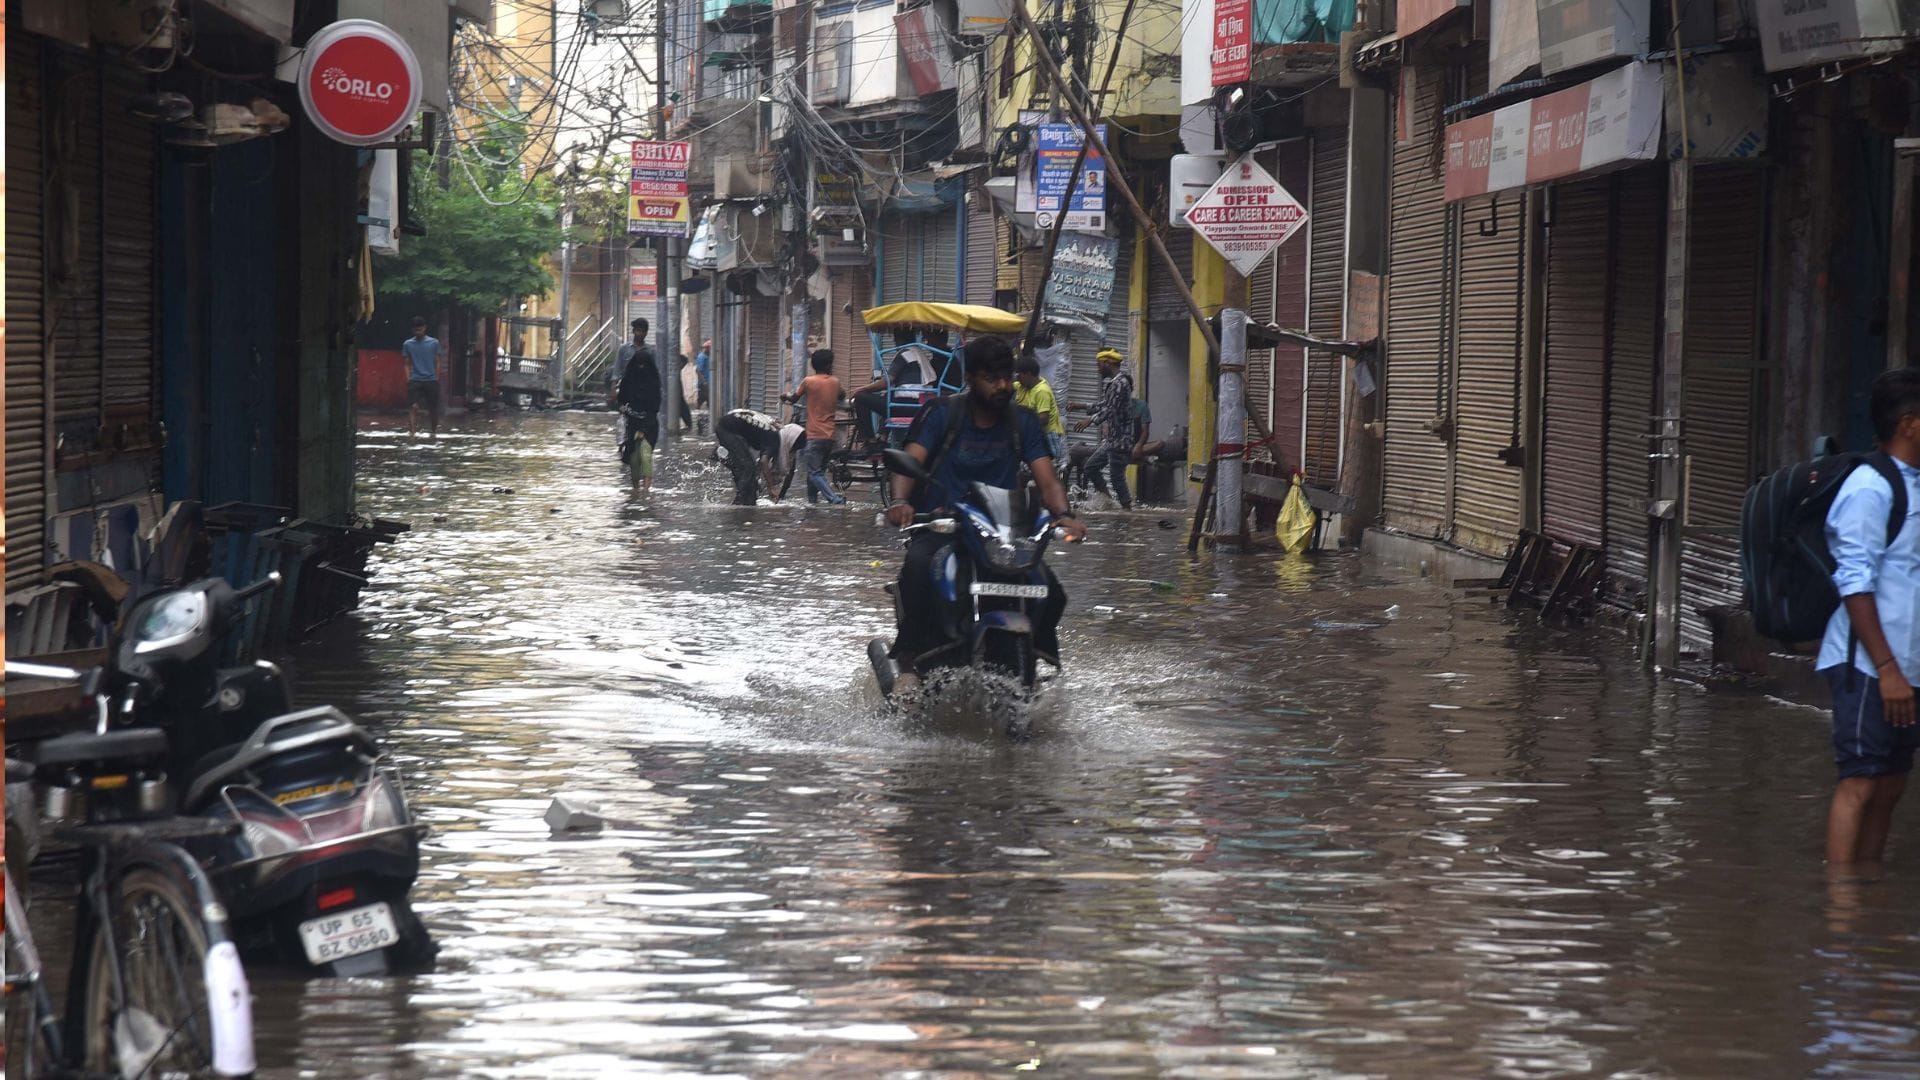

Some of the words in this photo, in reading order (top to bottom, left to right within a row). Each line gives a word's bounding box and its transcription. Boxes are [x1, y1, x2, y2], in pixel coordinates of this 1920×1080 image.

[336, 77, 393, 99] ORLO
[635, 143, 686, 161] SHIVA
[1217, 185, 1275, 195] ADMISSIONS
[1223, 195, 1268, 206] OPEN
[645, 206, 674, 216] OPEN
[1195, 208, 1218, 222] CARE
[1219, 209, 1227, 222] &
[1228, 208, 1262, 221] CAREER
[1264, 206, 1299, 221] SCHOOL
[1204, 225, 1237, 234] Playgroup
[1269, 223, 1288, 231] CBSE
[1052, 272, 1112, 291] VISHRAM
[1055, 283, 1105, 301] PALACE
[320, 920, 342, 936] UP
[352, 911, 374, 928] 65
[318, 941, 344, 957] BZ
[348, 928, 390, 951] 0680
